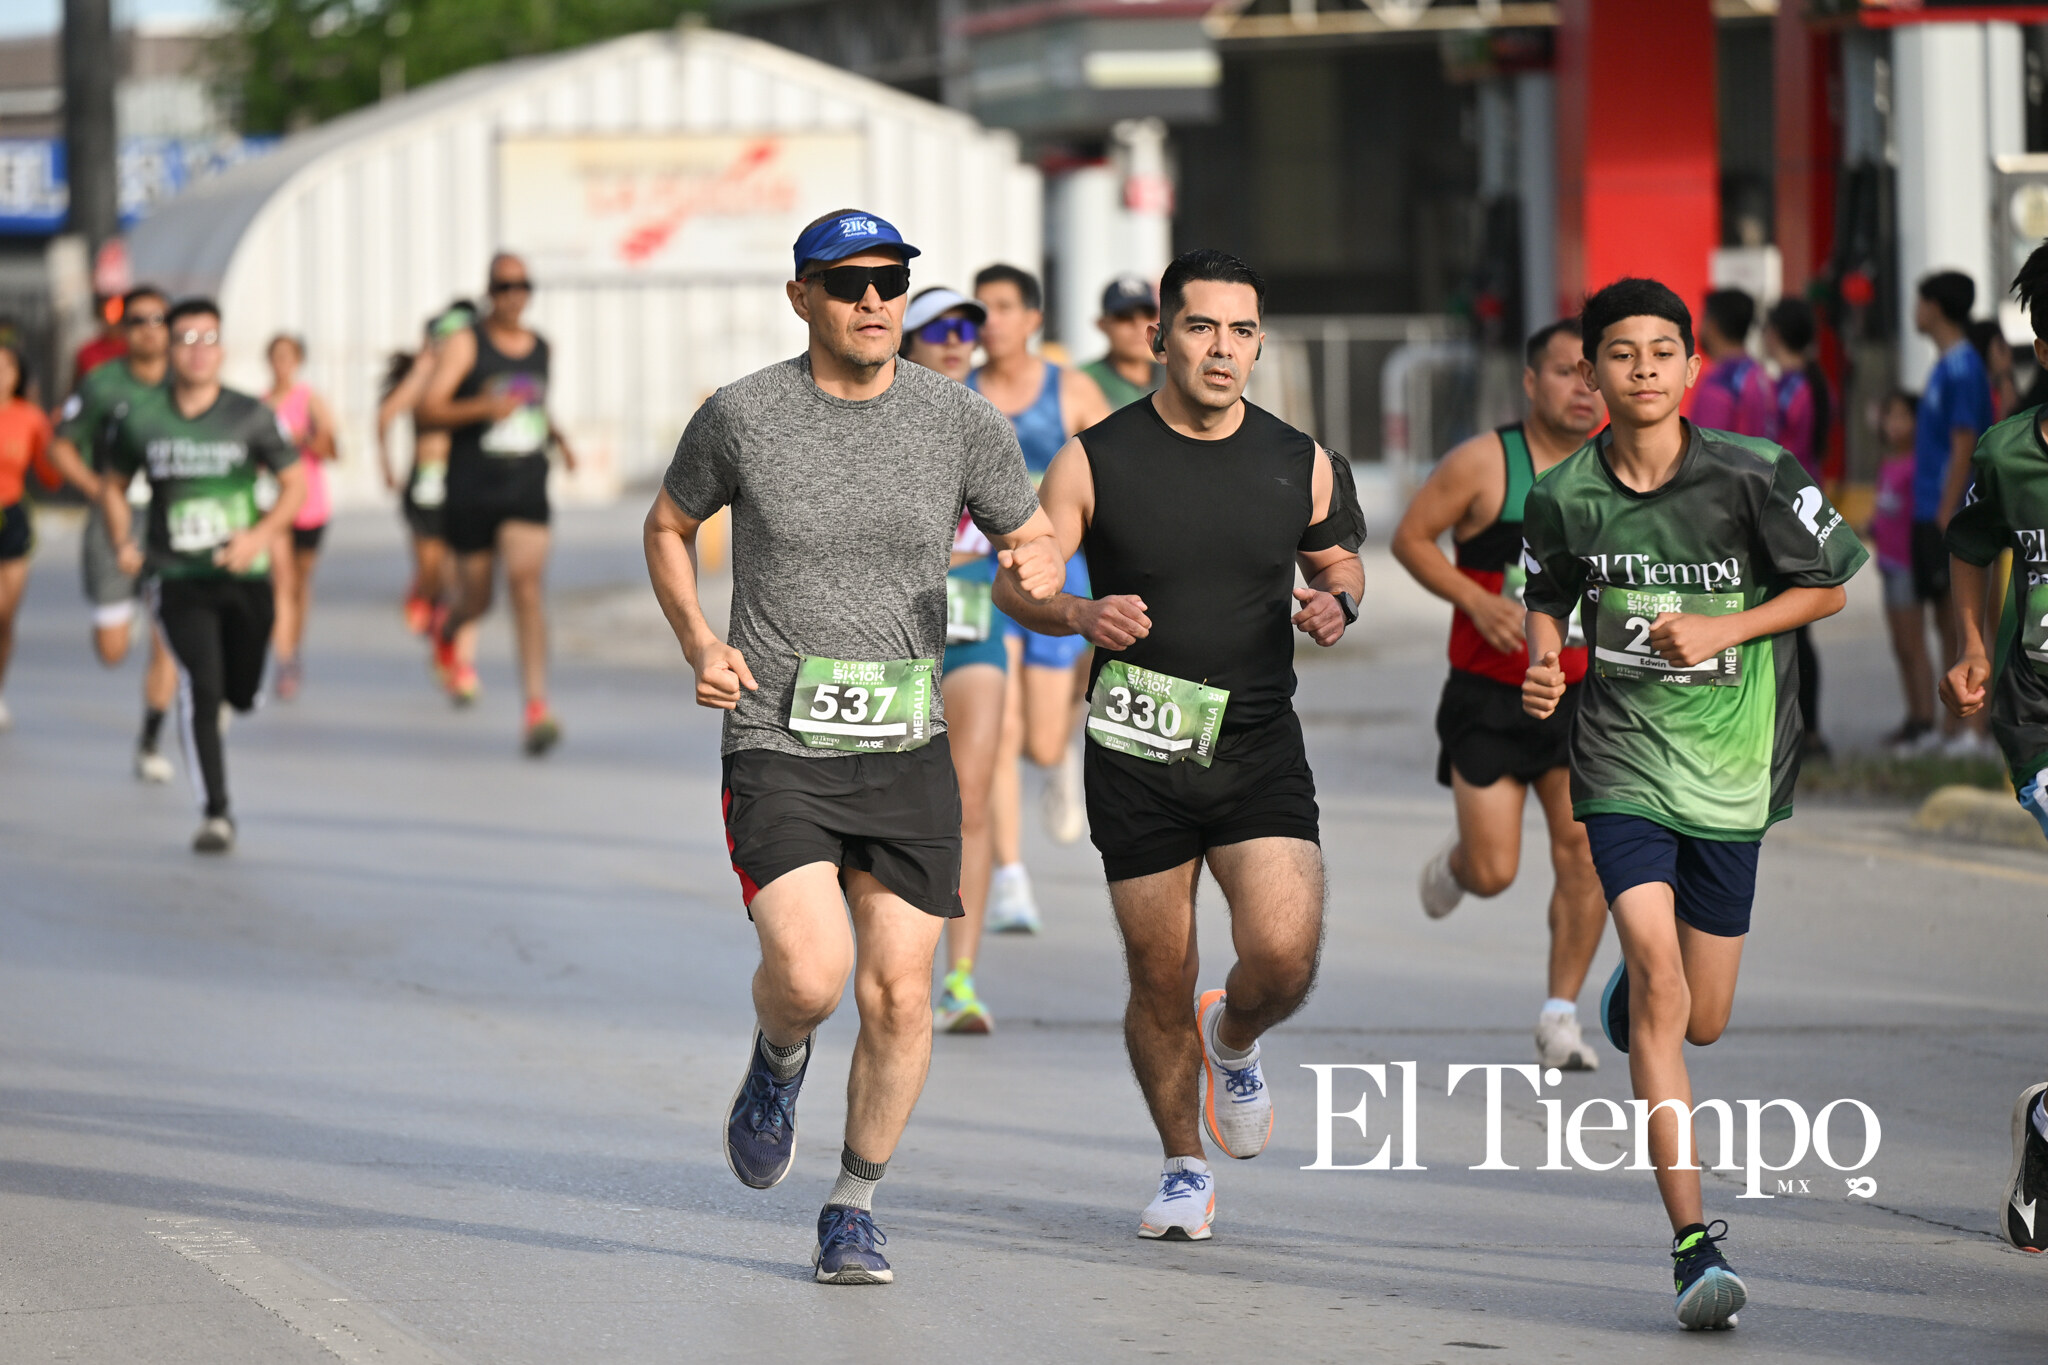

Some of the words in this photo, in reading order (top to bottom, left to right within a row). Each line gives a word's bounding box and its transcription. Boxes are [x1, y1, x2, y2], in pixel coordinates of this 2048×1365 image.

[1614, 553, 1741, 591] Tiempo
[1626, 592, 1683, 603] CARRERA
[1725, 600, 1738, 609] 22
[833, 661, 886, 671] CARRERA
[912, 664, 930, 672] 537
[1640, 657, 1667, 668] Edwin
[1127, 666, 1173, 685] CARRERA
[809, 683, 898, 723] 537
[1208, 692, 1225, 703] 330
[912, 677, 925, 740] MEDALLA
[1105, 686, 1182, 738] 330
[1196, 707, 1219, 757] MEDALLA
